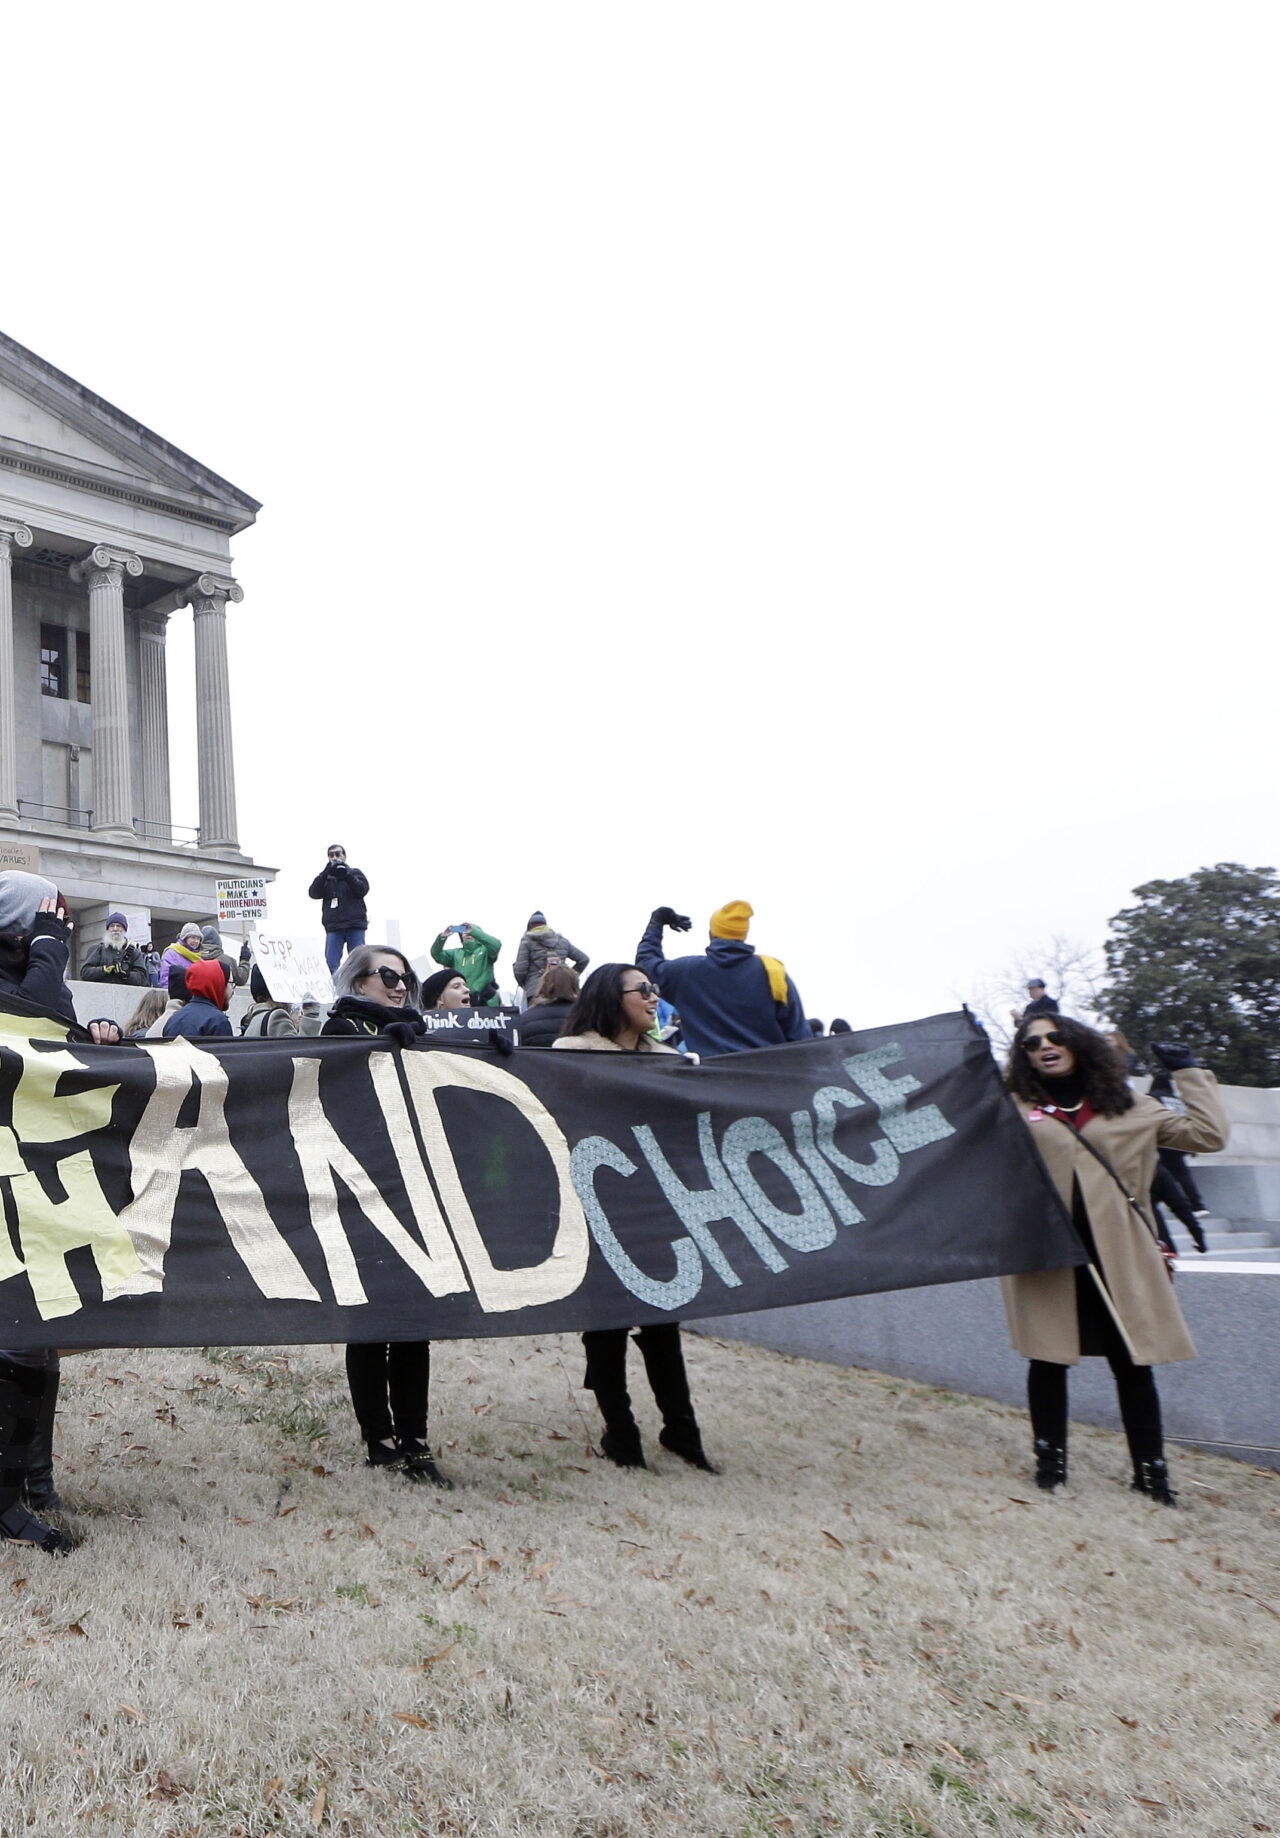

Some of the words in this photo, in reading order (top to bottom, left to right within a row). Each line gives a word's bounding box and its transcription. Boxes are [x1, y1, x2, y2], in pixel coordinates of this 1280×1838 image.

[217, 879, 264, 890] POLITICIANS
[226, 890, 248, 899] MAKE
[219, 898, 267, 908] HORRENDOUS
[226, 909, 262, 919] OB-GYNS
[259, 933, 293, 959] STOP
[467, 1011, 511, 1029] about
[101, 1035, 590, 1313] AND
[570, 1042, 957, 1312] CHOICE
